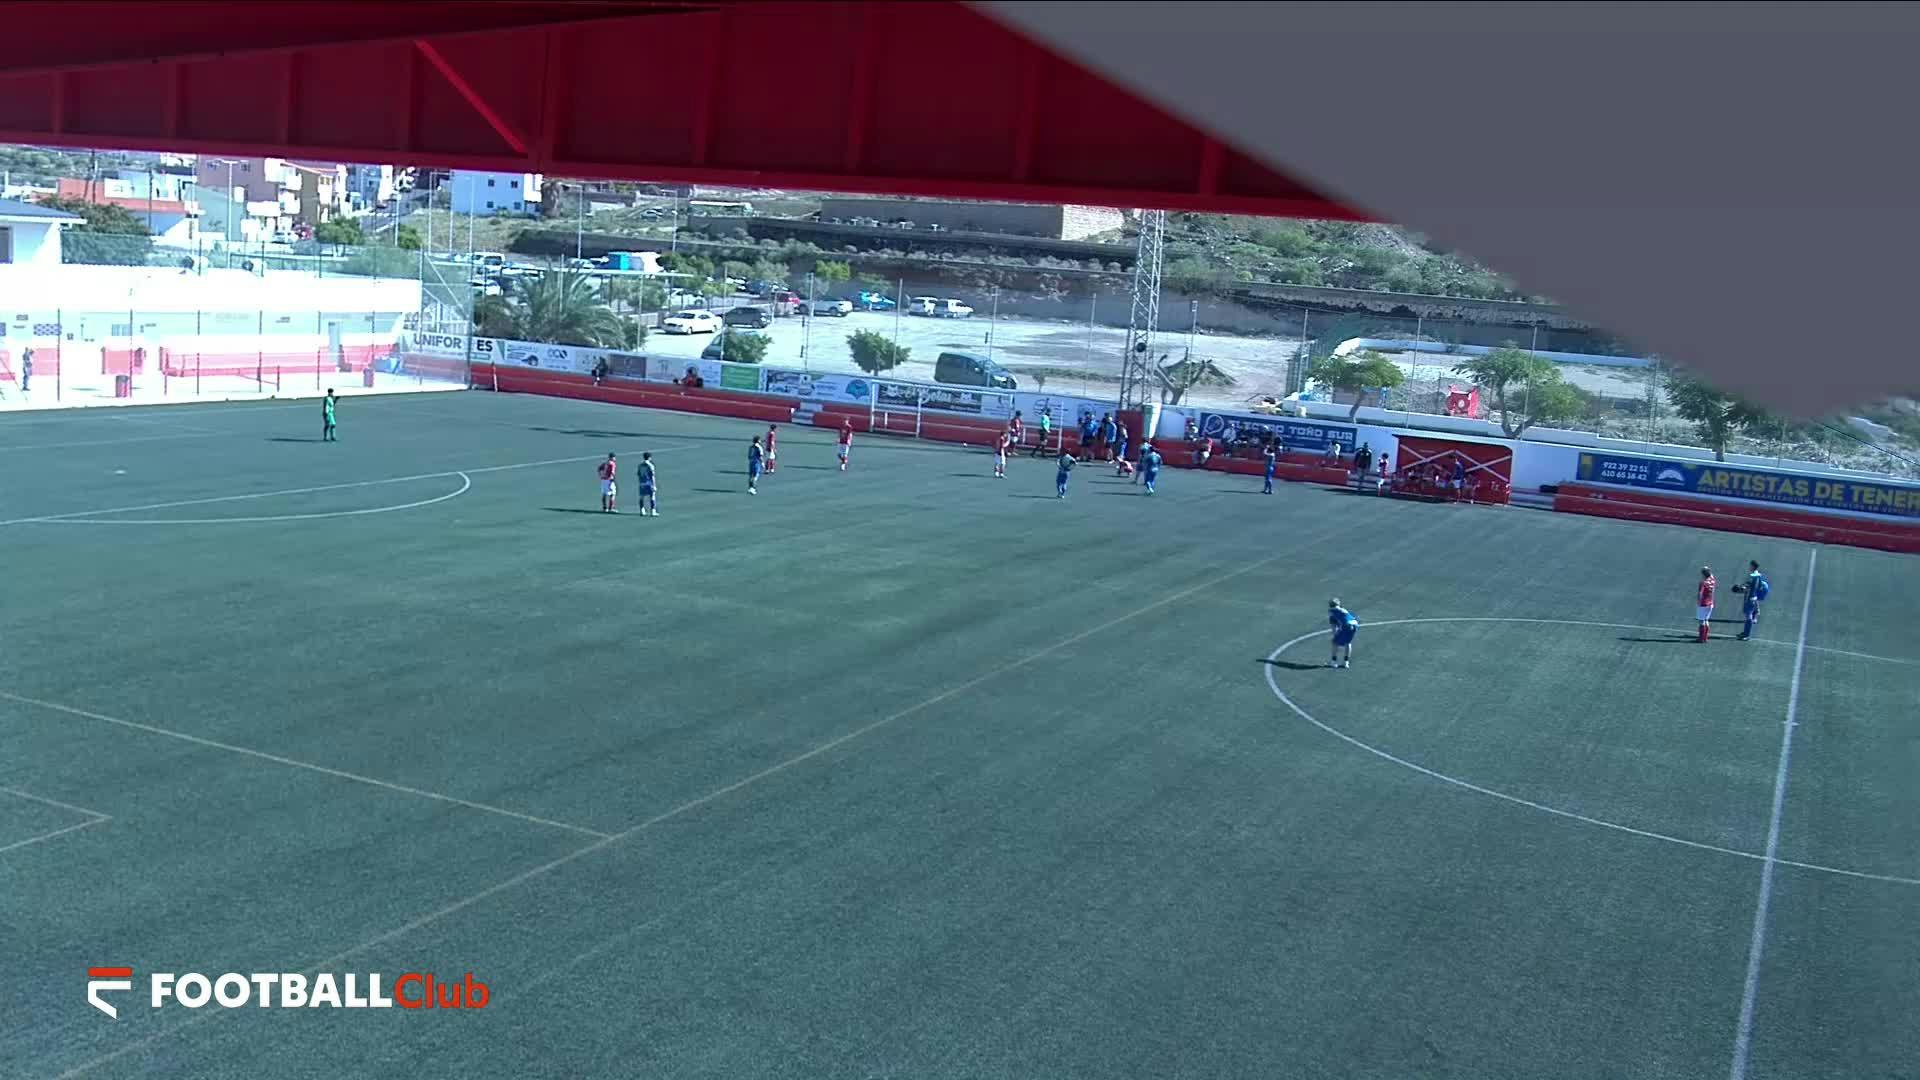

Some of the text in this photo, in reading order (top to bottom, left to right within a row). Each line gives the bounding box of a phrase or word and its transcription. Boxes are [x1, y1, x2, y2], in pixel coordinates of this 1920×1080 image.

[413, 333, 493, 352] UNIFORES
[1327, 430, 1353, 441] SUR
[1698, 469, 1809, 497] ARTISTAS
[1814, 481, 1845, 501] DE
